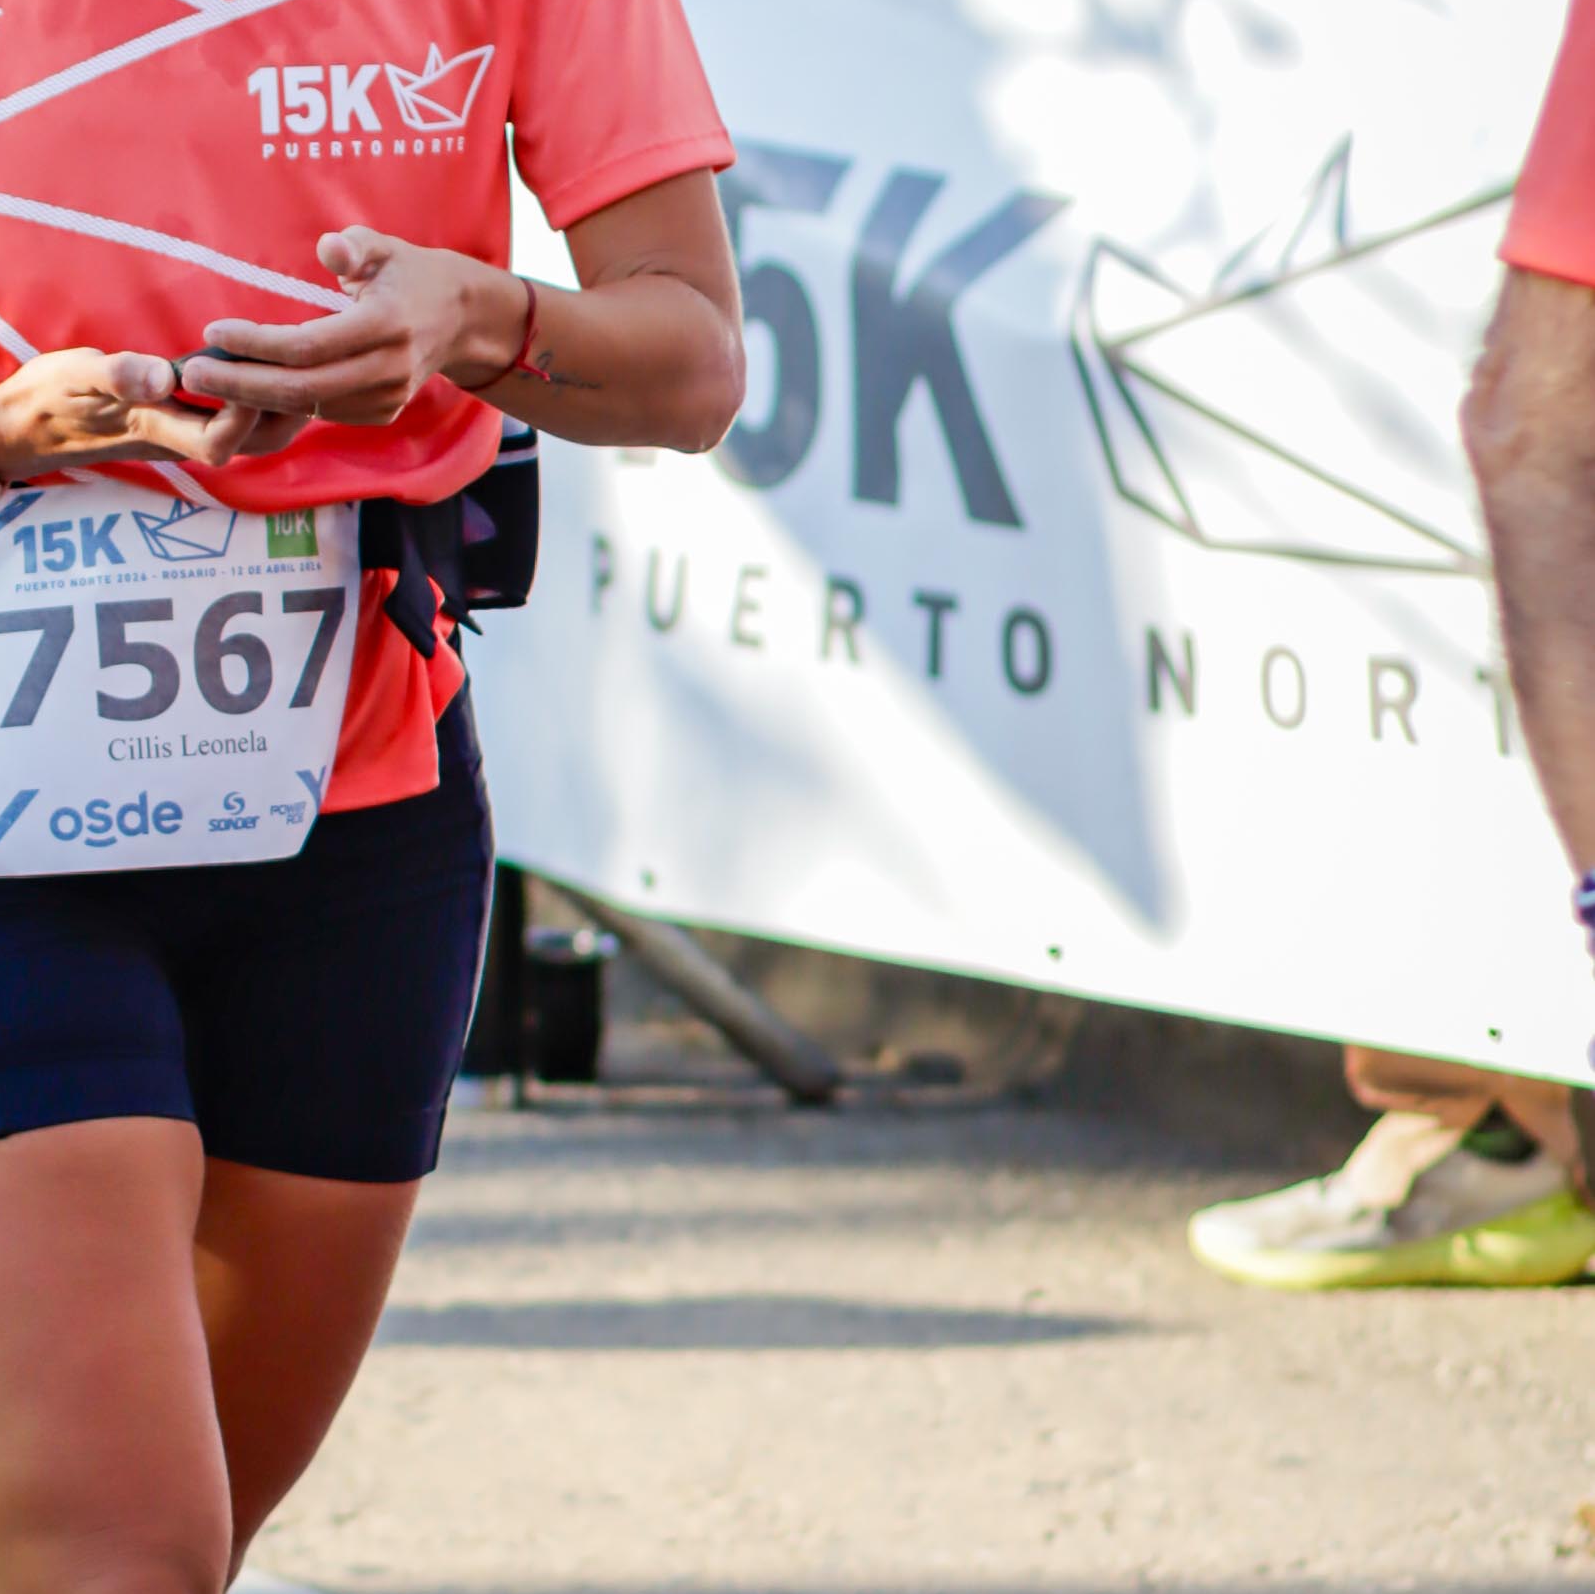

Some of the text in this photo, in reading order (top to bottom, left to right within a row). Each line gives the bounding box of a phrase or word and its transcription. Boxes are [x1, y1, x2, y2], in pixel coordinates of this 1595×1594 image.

[247, 64, 383, 136] 15K
[262, 136, 465, 160] PUERTO NORTE
[616, 138, 1074, 531] 5K
[13, 513, 126, 574] 15K
[15, 579, 66, 594] PUERTO
[70, 574, 112, 588] NORTE
[162, 567, 217, 580] ROSARIO
[248, 564, 262, 576] DE
[266, 562, 296, 574] ABRIL
[591, 532, 1052, 696] PUERTO
[108, 729, 268, 762] Cillis Leonela
[49, 791, 183, 847] osde
